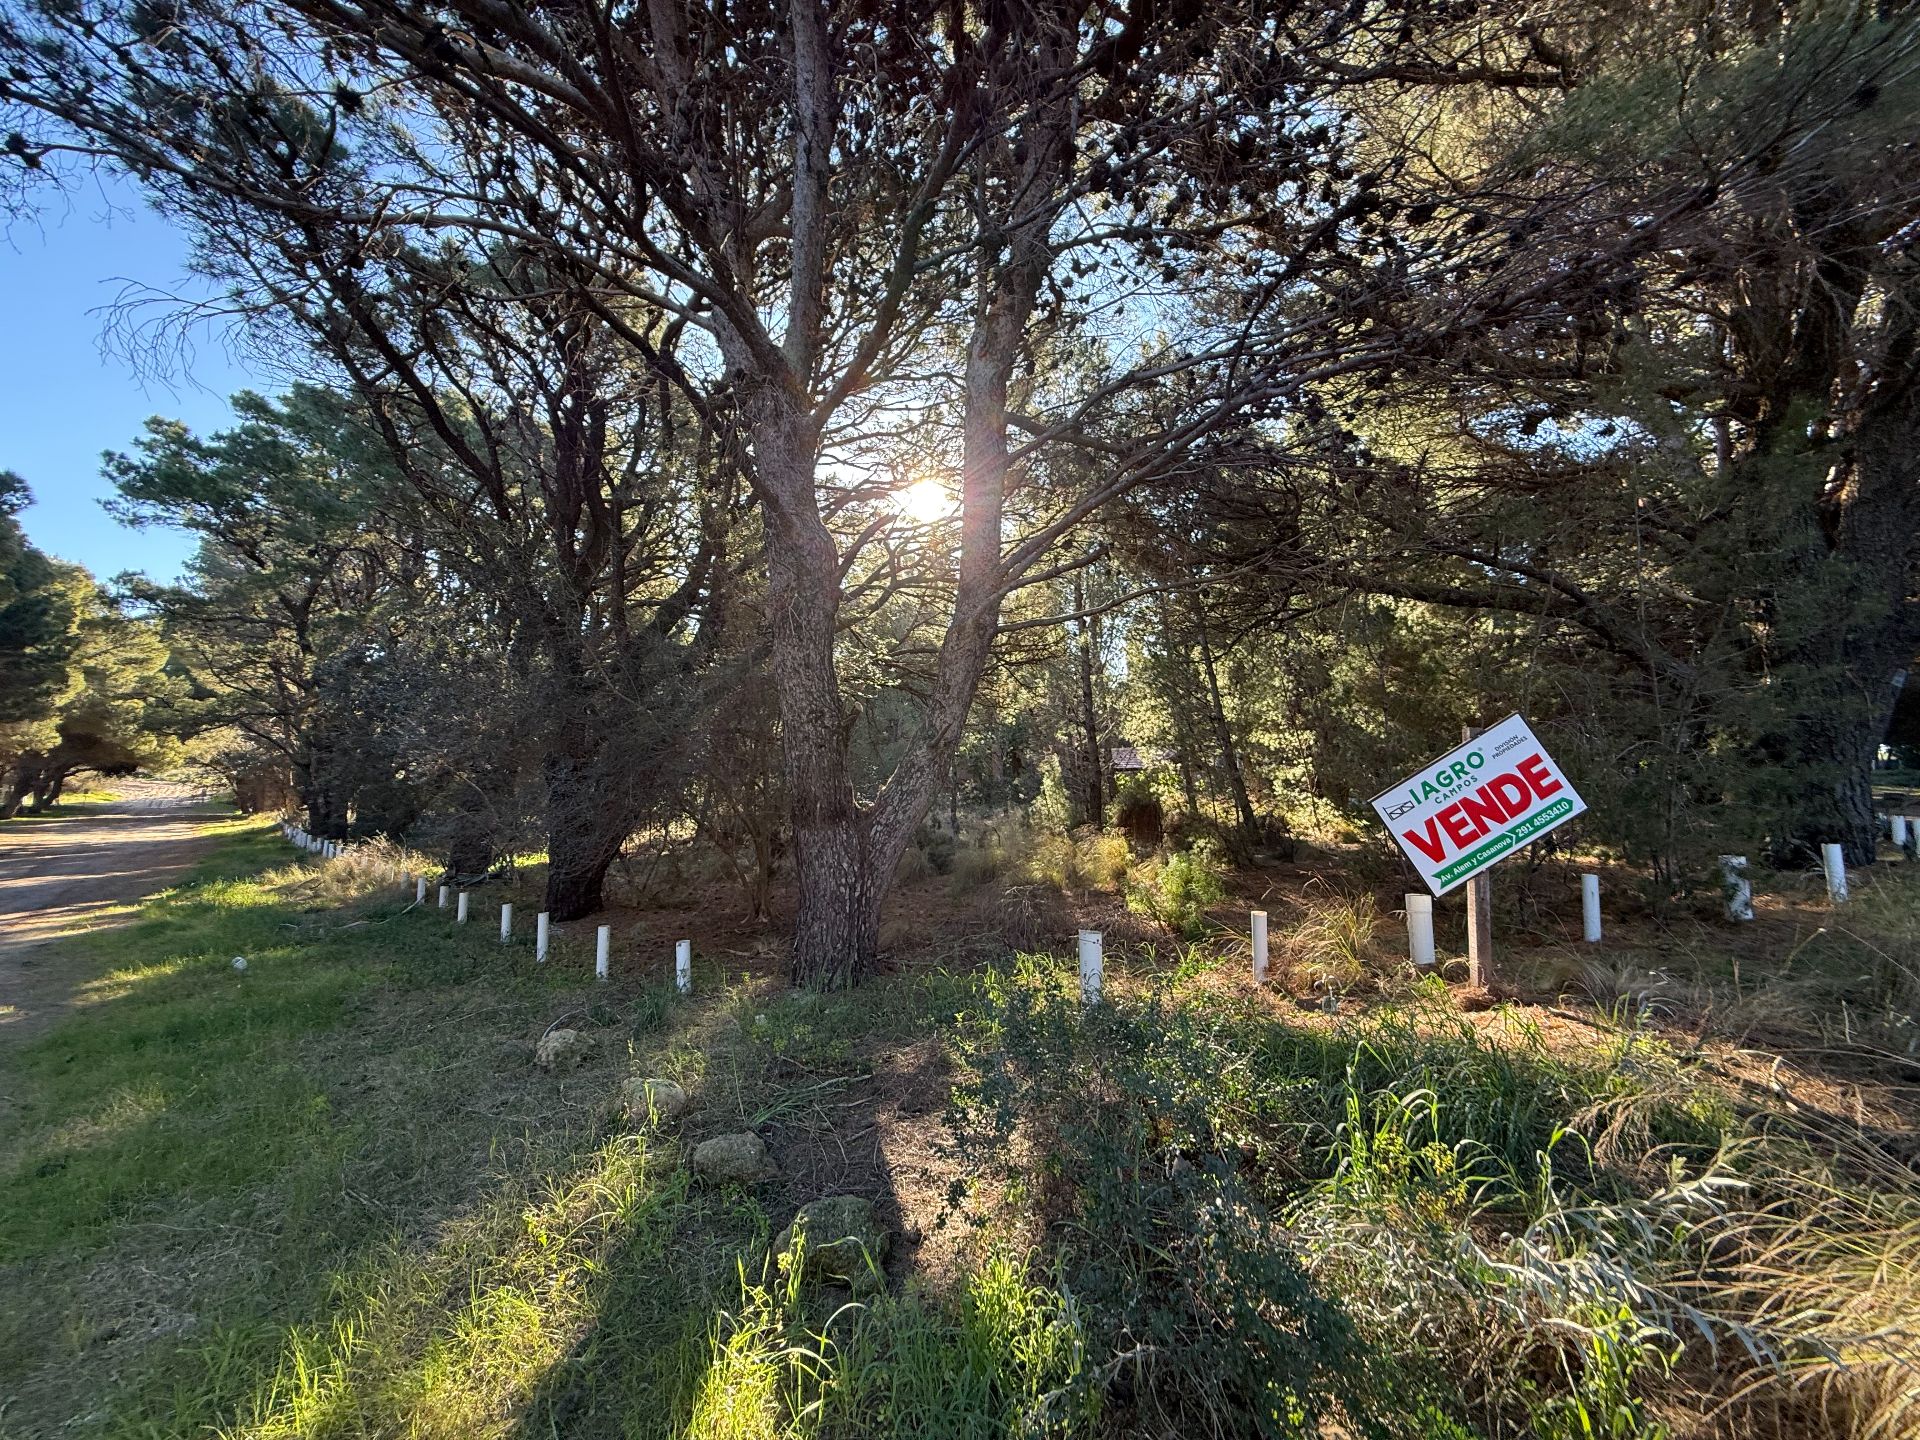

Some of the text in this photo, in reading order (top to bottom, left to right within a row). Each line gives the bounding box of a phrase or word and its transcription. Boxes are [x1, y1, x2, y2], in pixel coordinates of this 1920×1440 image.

[1491, 735, 1528, 760] PROPIEDADES
[1408, 751, 1485, 805] IAGRO
[1434, 775, 1478, 804] CAMPOS
[1402, 752, 1564, 864] VENDE
[1515, 801, 1570, 838] 291 4553410
[1440, 837, 1512, 883] Av. Alem y Casanova
